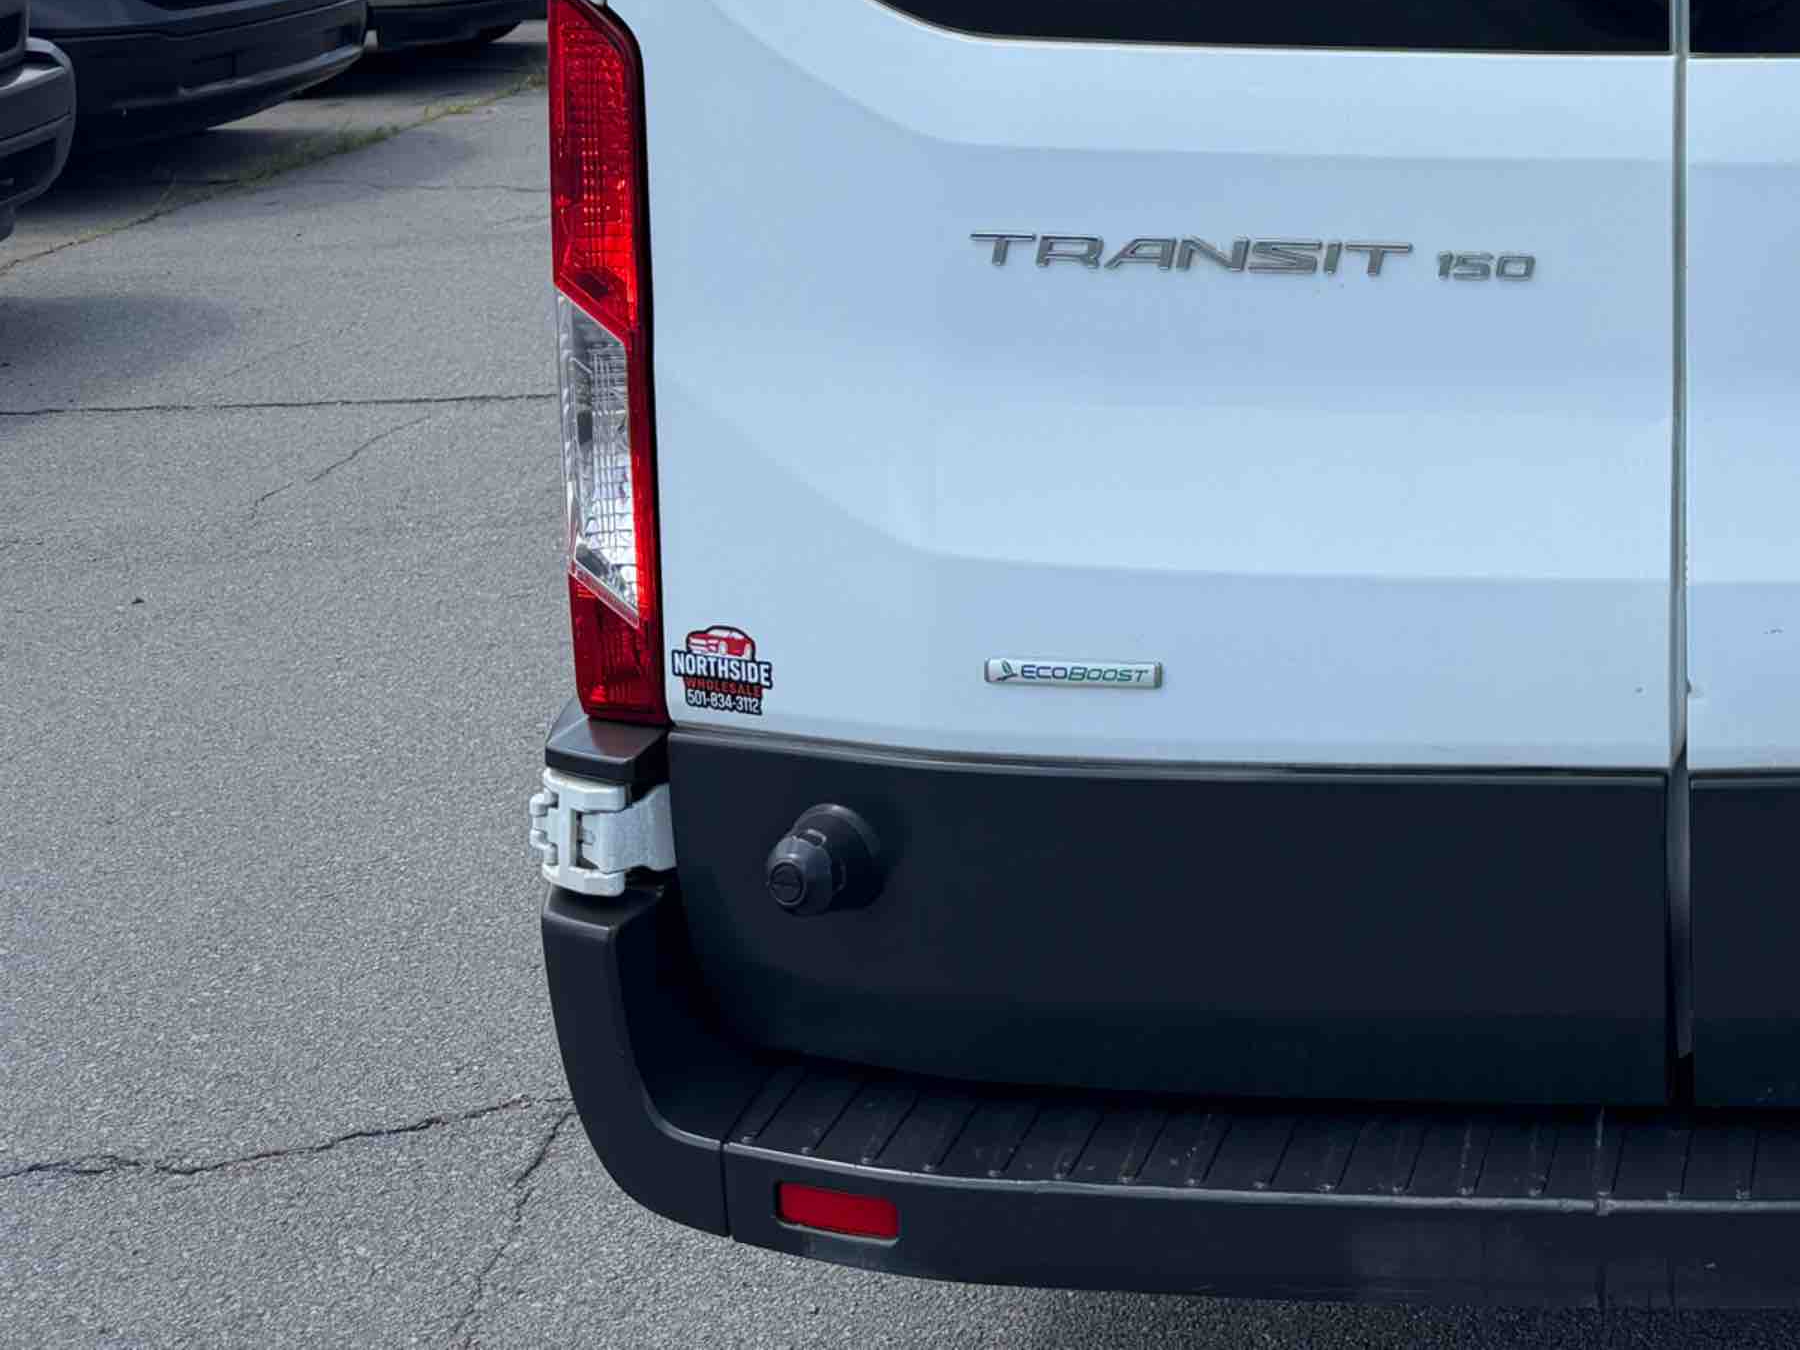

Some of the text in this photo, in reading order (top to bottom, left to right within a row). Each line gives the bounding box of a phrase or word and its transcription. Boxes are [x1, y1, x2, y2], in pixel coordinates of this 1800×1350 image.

[970, 233, 1535, 281] TRANSIT 150
[673, 652, 770, 687] NORTHSIDE
[684, 678, 761, 698] WHOLESALE
[687, 689, 759, 713] 501-834-3112
